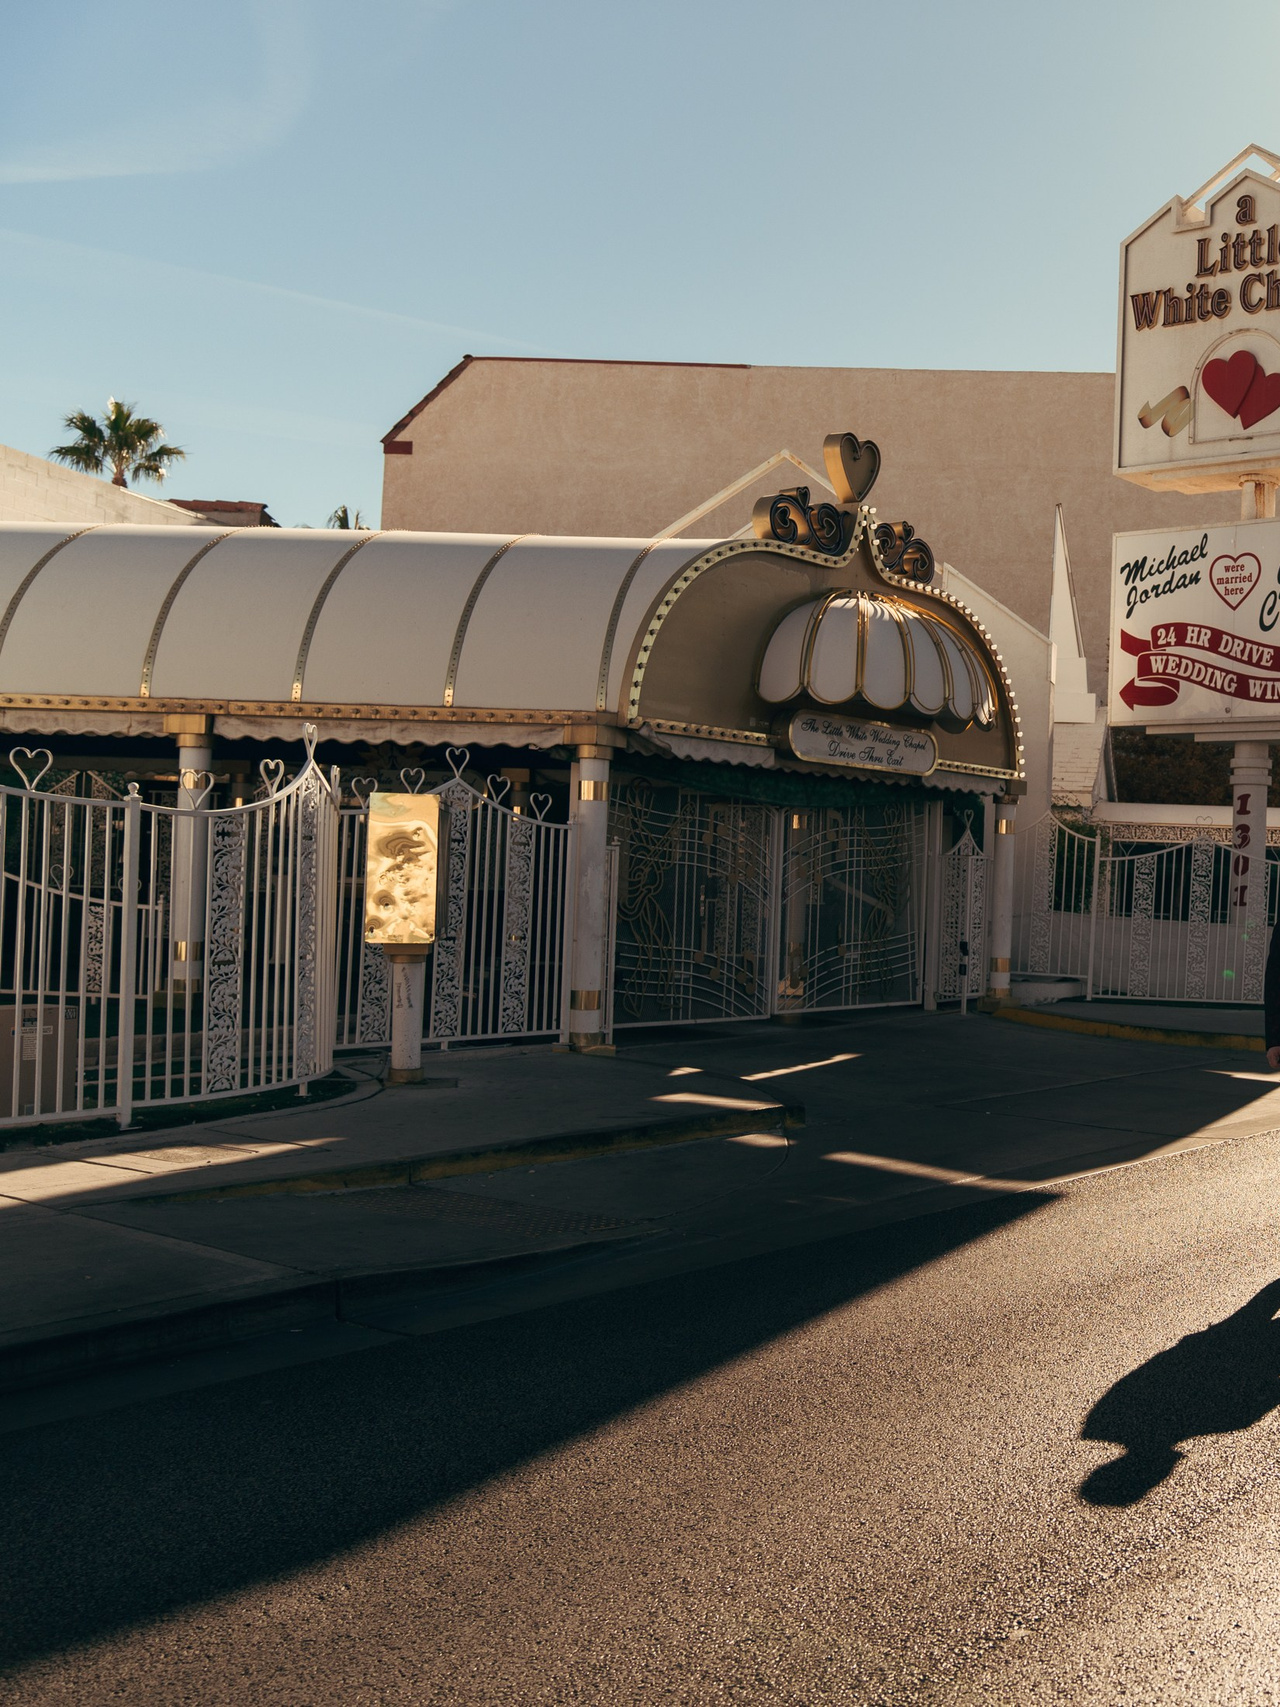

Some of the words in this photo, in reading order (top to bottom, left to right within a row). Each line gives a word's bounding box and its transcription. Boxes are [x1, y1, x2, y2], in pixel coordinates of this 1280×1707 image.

[1235, 195, 1256, 226] a
[1130, 282, 1231, 331] White
[1120, 533, 1208, 586] Michael
[1224, 563, 1245, 573] were
[1125, 570, 1202, 619] Jordan
[1216, 573, 1253, 585] married
[1224, 586, 1244, 596] here
[1157, 627, 1177, 646] 24
[1185, 626, 1212, 648] HR
[1218, 634, 1274, 667] DRIVE
[1150, 655, 1238, 694] WEDDING
[801, 718, 819, 733] The
[822, 721, 844, 738] Little
[846, 724, 868, 742] White
[870, 728, 901, 751] Wedding
[902, 734, 927, 753] Chapel
[828, 740, 856, 759] Drive
[859, 746, 884, 765] Thru
[886, 749, 904, 767] Exit
[1233, 793, 1251, 907] 1301
